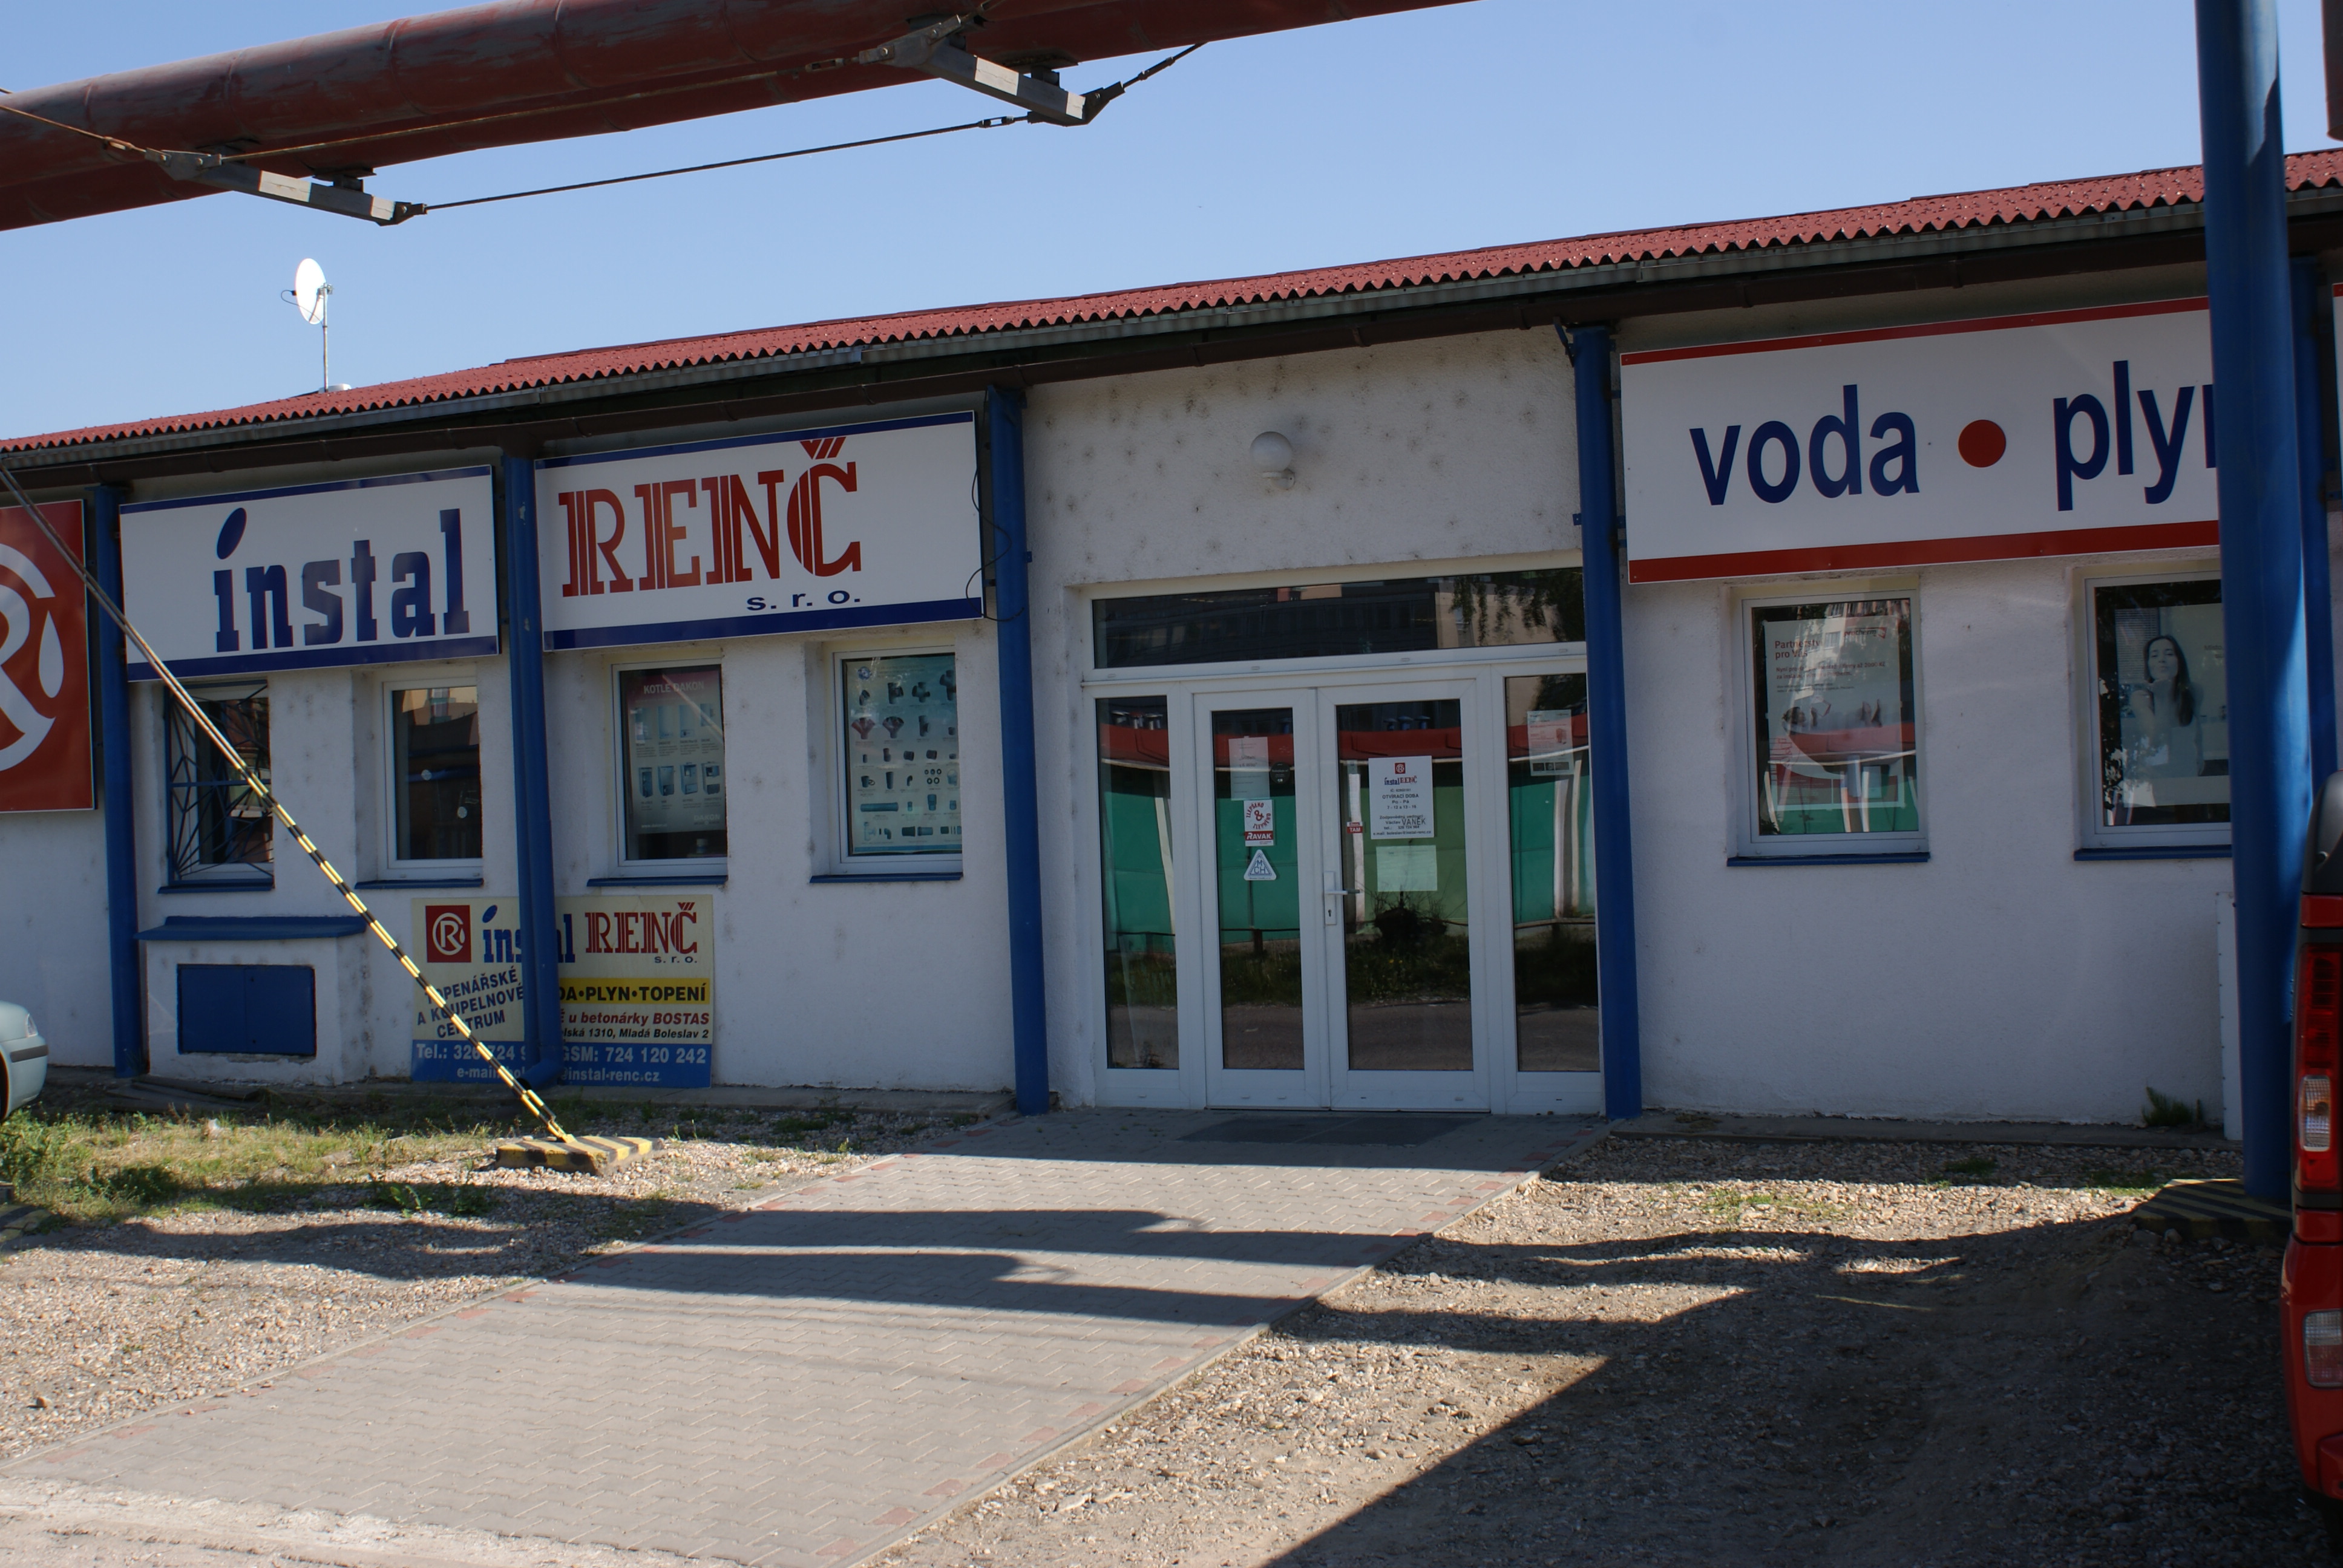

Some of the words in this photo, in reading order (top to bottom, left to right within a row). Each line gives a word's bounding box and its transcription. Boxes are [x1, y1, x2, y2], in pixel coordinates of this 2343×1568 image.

[1689, 384, 1919, 505] voda
[559, 436, 862, 597] RENČ
[746, 596, 777, 611] s.
[792, 592, 812, 607] r.
[828, 589, 860, 604] o.
[1775, 639, 1823, 648] Partnerstv
[1775, 652, 1790, 660] pro
[643, 684, 671, 694] KOTLE
[673, 681, 705, 691] DAKON
[1401, 816, 1426, 826] VANĚK
[585, 902, 697, 954] RENČ
[418, 1011, 426, 1025] A
[437, 1010, 505, 1038] CETRUM
[569, 1014, 577, 1024] u
[581, 1011, 649, 1027] betonárky
[653, 1012, 709, 1025] BOSTAS
[589, 1028, 616, 1039] 1310,
[619, 1028, 650, 1038] Mladá
[654, 1029, 699, 1039] Boleslav
[702, 1029, 709, 1039] 2
[416, 1044, 447, 1059] Tel.:
[563, 1046, 599, 1062] GSM:
[606, 1047, 634, 1062] 724
[641, 1047, 669, 1063] 120
[676, 1048, 706, 1064] 242
